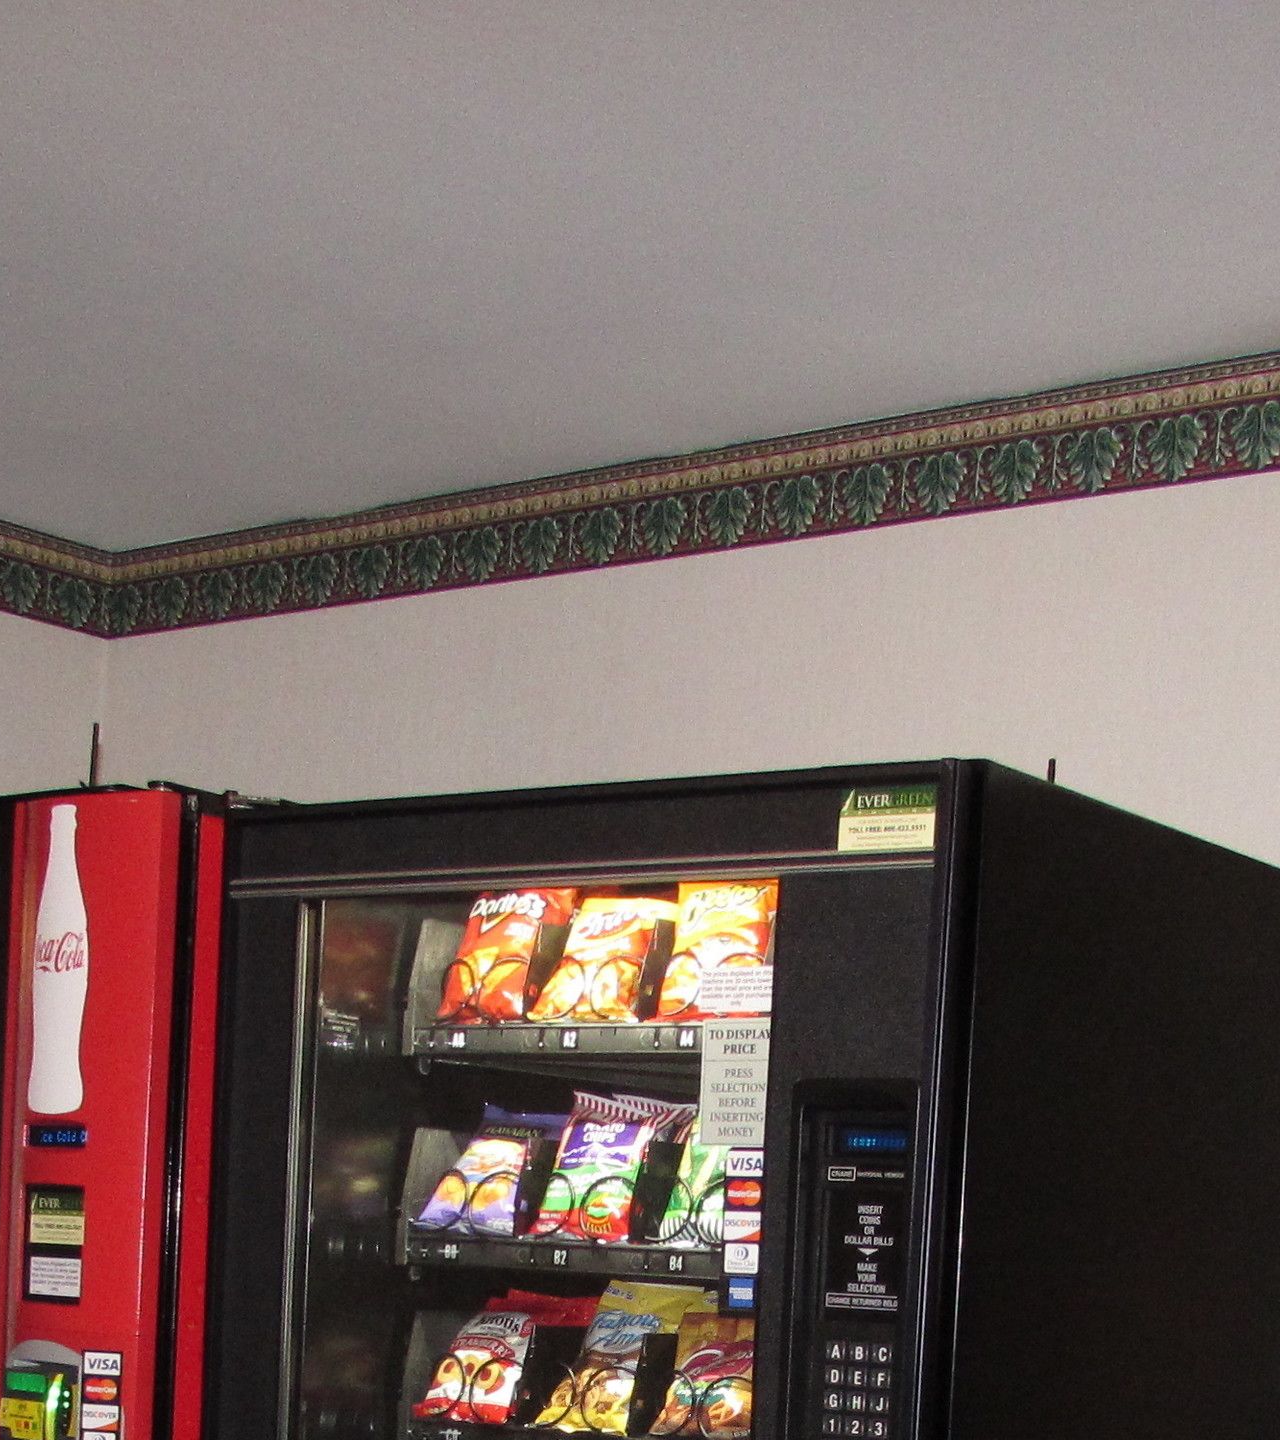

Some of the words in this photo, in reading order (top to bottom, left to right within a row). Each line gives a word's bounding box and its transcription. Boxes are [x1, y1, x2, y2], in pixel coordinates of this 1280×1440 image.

[469, 893, 546, 920] Doritos
[34, 931, 85, 973] oca-Cola
[709, 1029, 723, 1040] TO
[726, 1029, 771, 1040] DISPLAY
[723, 1043, 757, 1055] PRICE
[724, 1068, 753, 1078] PRESS
[710, 1082, 766, 1093] SELECTION
[718, 1097, 756, 1108] BEFORE
[709, 1111, 764, 1122] INSERTING
[583, 1131, 616, 1144] CHIPS
[717, 1126, 755, 1138] MONEY
[730, 1157, 763, 1171] VISA
[857, 1205, 883, 1215] INSERT
[724, 1218, 761, 1229] DISCOVER
[858, 1215, 881, 1225] COINS
[863, 1225, 875, 1236] OR
[844, 1235, 872, 1246] DOLLAR
[873, 1236, 894, 1247] BILLS
[856, 1262, 878, 1273] MAKE
[857, 1272, 877, 1284] YOUR
[846, 1282, 887, 1294] SELECTION
[831, 1344, 840, 1359] A
[855, 1346, 863, 1360] B
[878, 1347, 887, 1362] C
[87, 1358, 120, 1371] VISA
[830, 1369, 839, 1383] D
[854, 1371, 862, 1385] E
[877, 1372, 885, 1387] F
[829, 1394, 838, 1408] G
[852, 1395, 861, 1410] H
[876, 1397, 884, 1412] J
[83, 1410, 117, 1420] DISCOVER
[829, 1419, 835, 1432] 1
[851, 1420, 860, 1434] 2
[875, 1422, 883, 1436] 3
